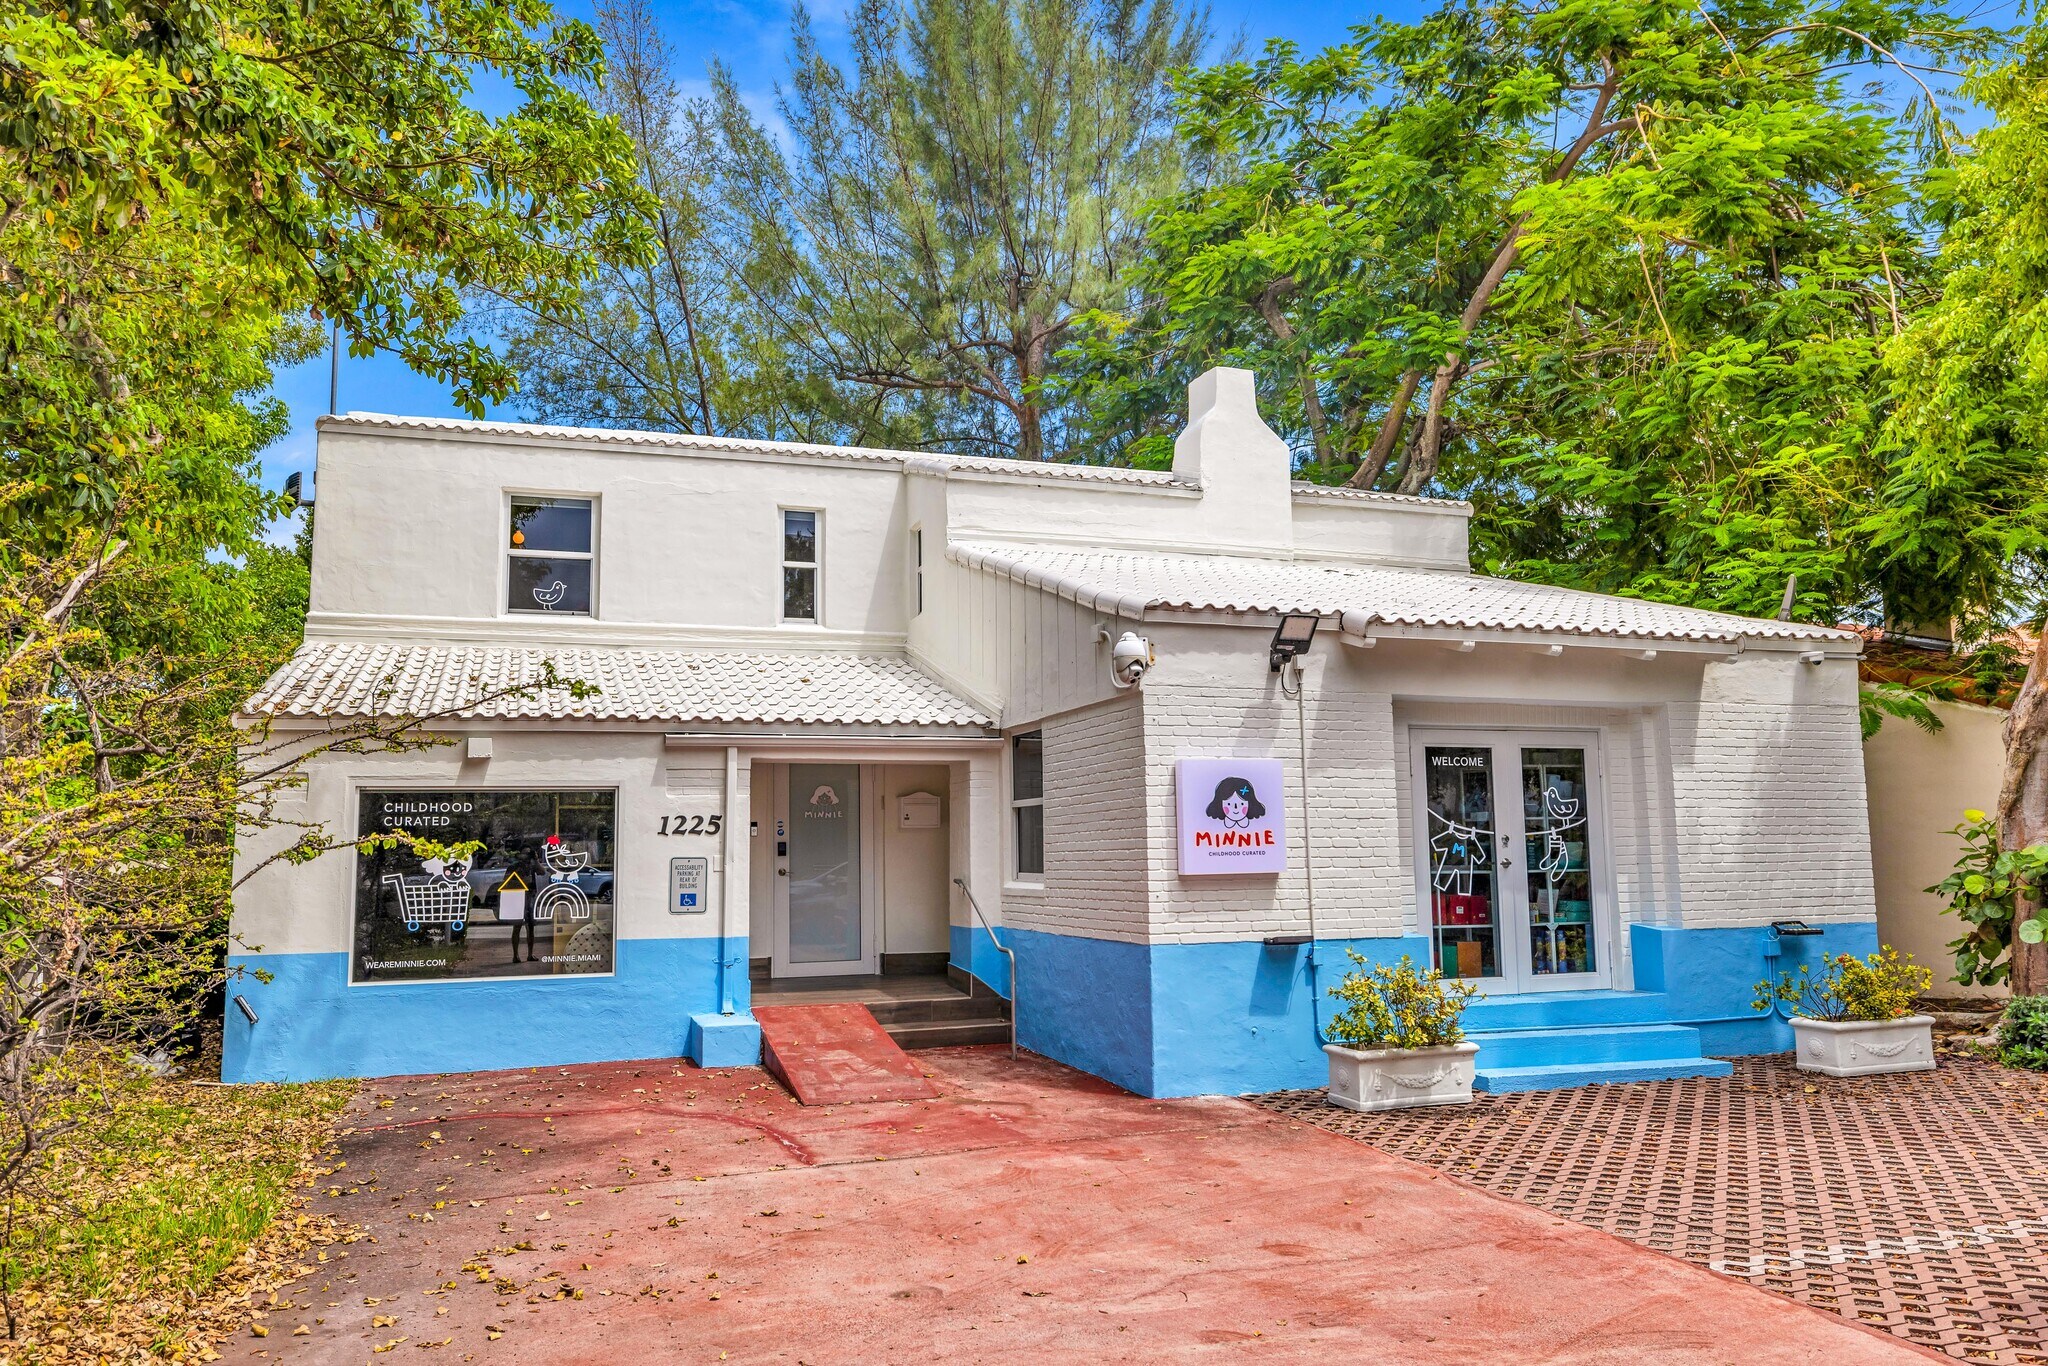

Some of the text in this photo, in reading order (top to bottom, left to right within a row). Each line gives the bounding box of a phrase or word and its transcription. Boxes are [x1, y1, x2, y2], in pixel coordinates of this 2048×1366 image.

[1431, 756, 1484, 767] WELCOME
[384, 802, 473, 813] CHILDHOOD
[384, 816, 450, 827] CURATED
[657, 815, 722, 836] 1225
[1195, 830, 1275, 848] MINNIE
[1452, 843, 1465, 858] M
[365, 959, 446, 969] WEAREMINNIE.COM
[541, 954, 601, 964] @MINNIE.MIAMI
